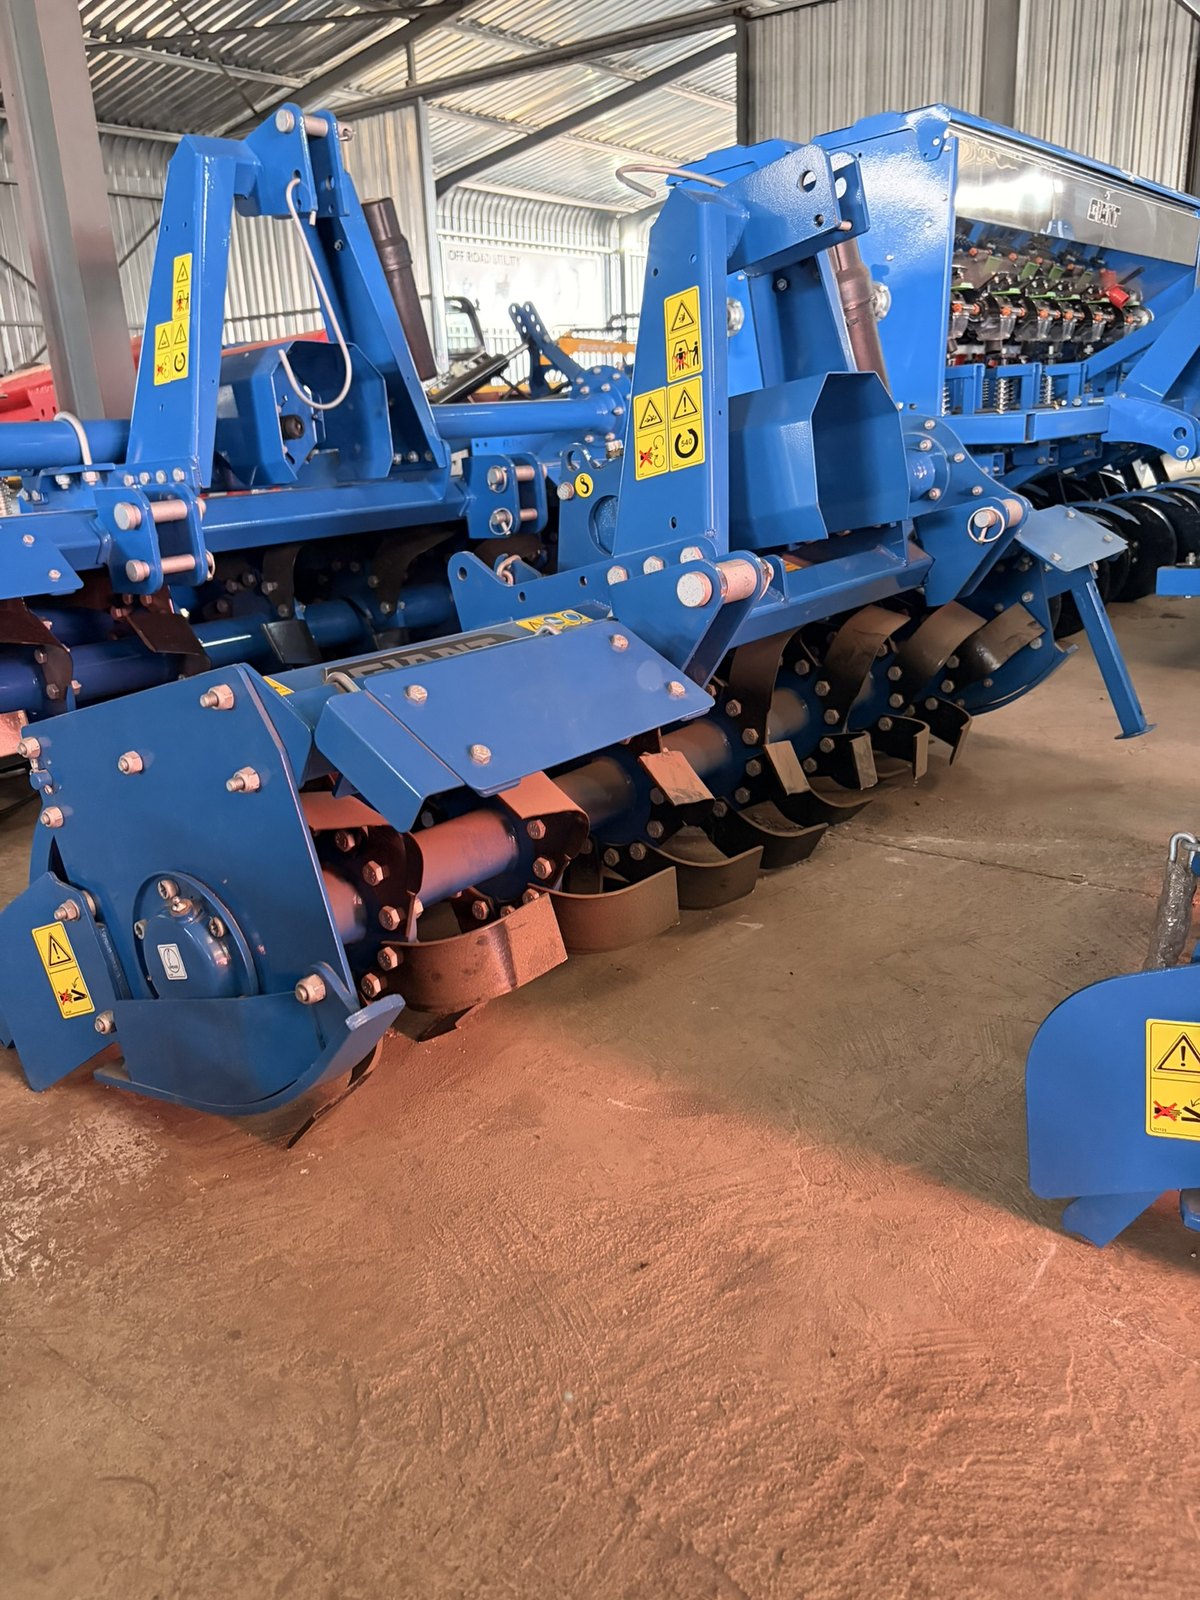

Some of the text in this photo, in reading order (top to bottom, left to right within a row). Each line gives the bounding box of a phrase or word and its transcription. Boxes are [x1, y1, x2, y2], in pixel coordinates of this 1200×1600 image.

[448, 249, 464, 261] OFF
[467, 251, 492, 264] ROAD
[681, 438, 693, 447] 540
